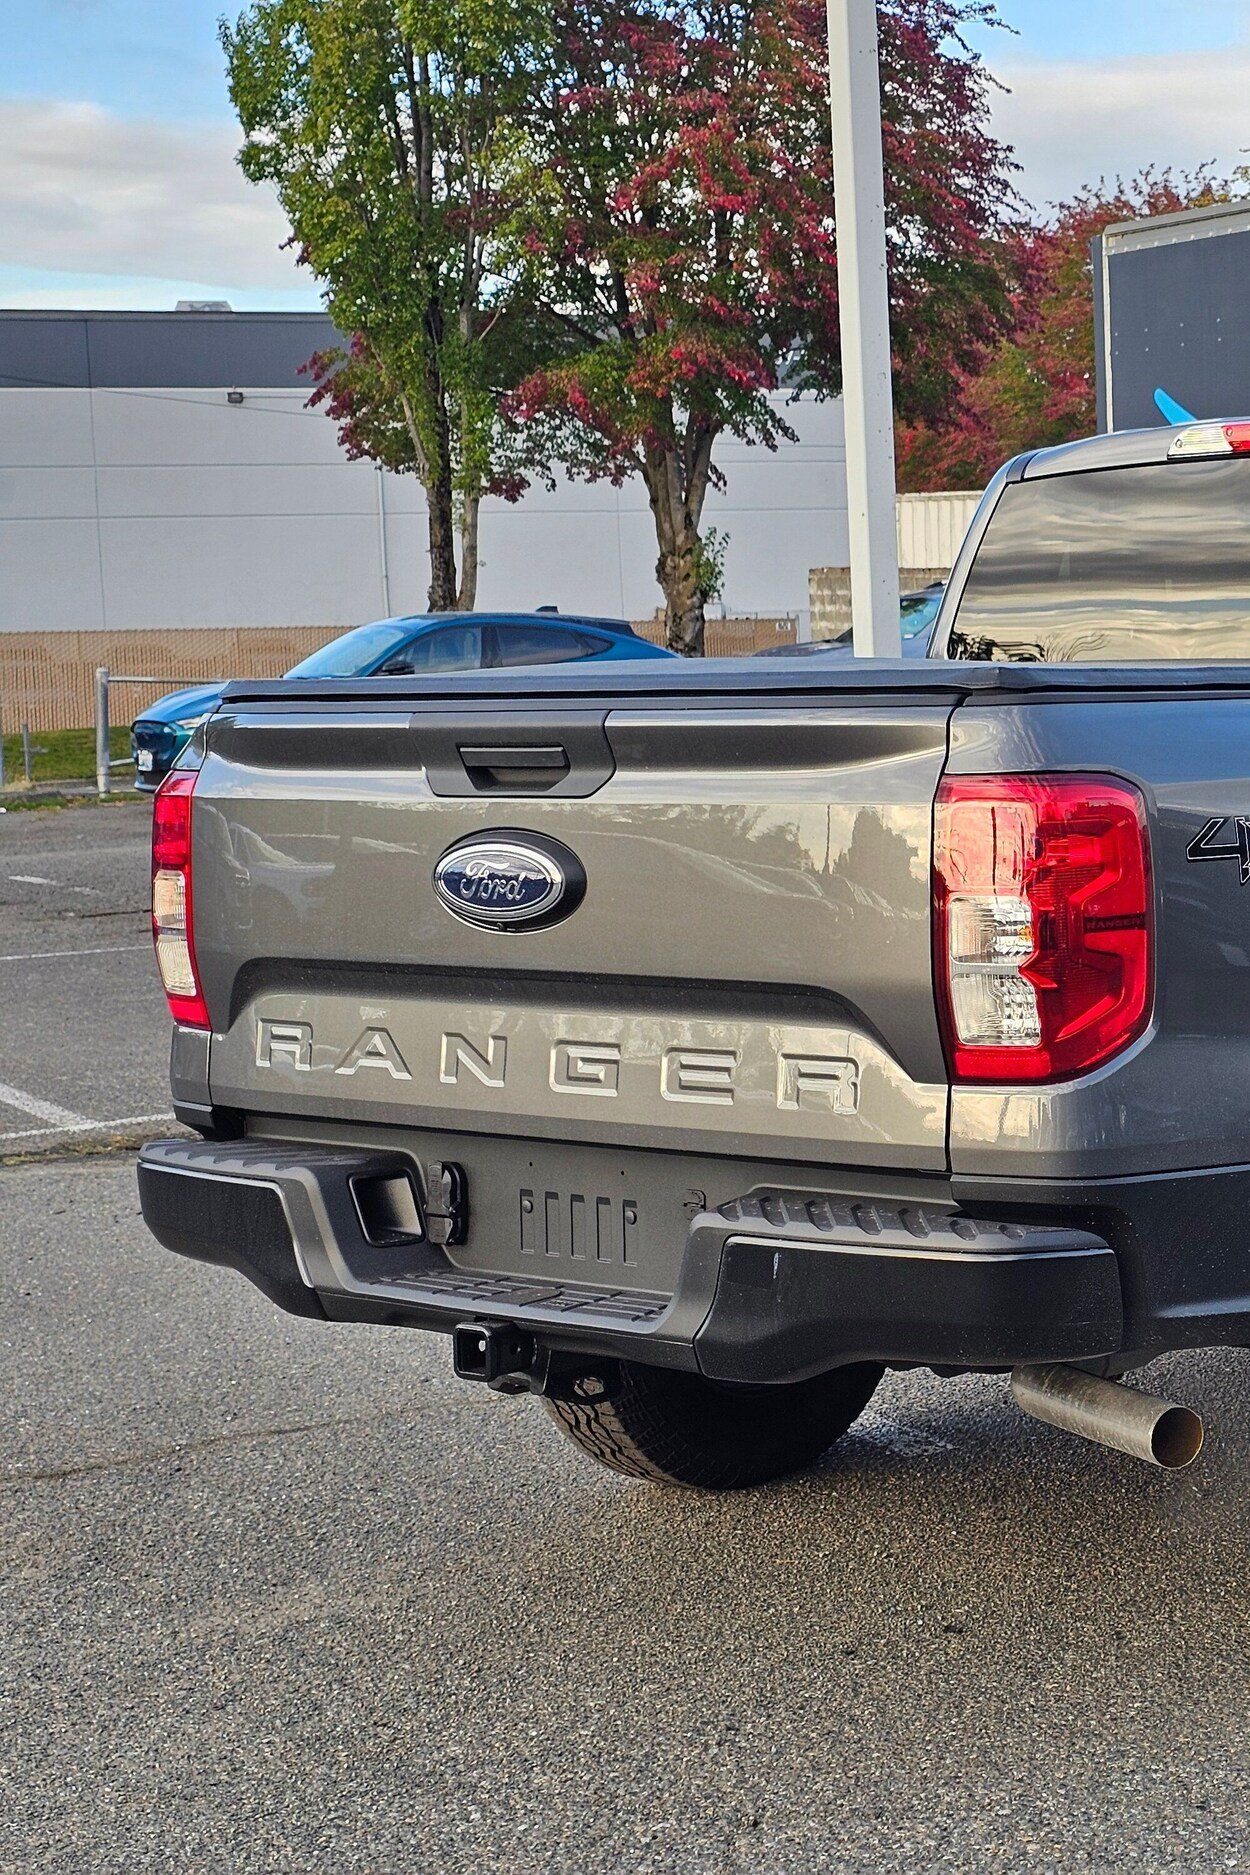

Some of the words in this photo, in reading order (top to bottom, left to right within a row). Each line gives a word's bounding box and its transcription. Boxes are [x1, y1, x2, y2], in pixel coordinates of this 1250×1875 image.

[460, 859, 526, 900] Ford
[1087, 918, 1140, 930] RANGER
[255, 1017, 861, 1116] RANGER
